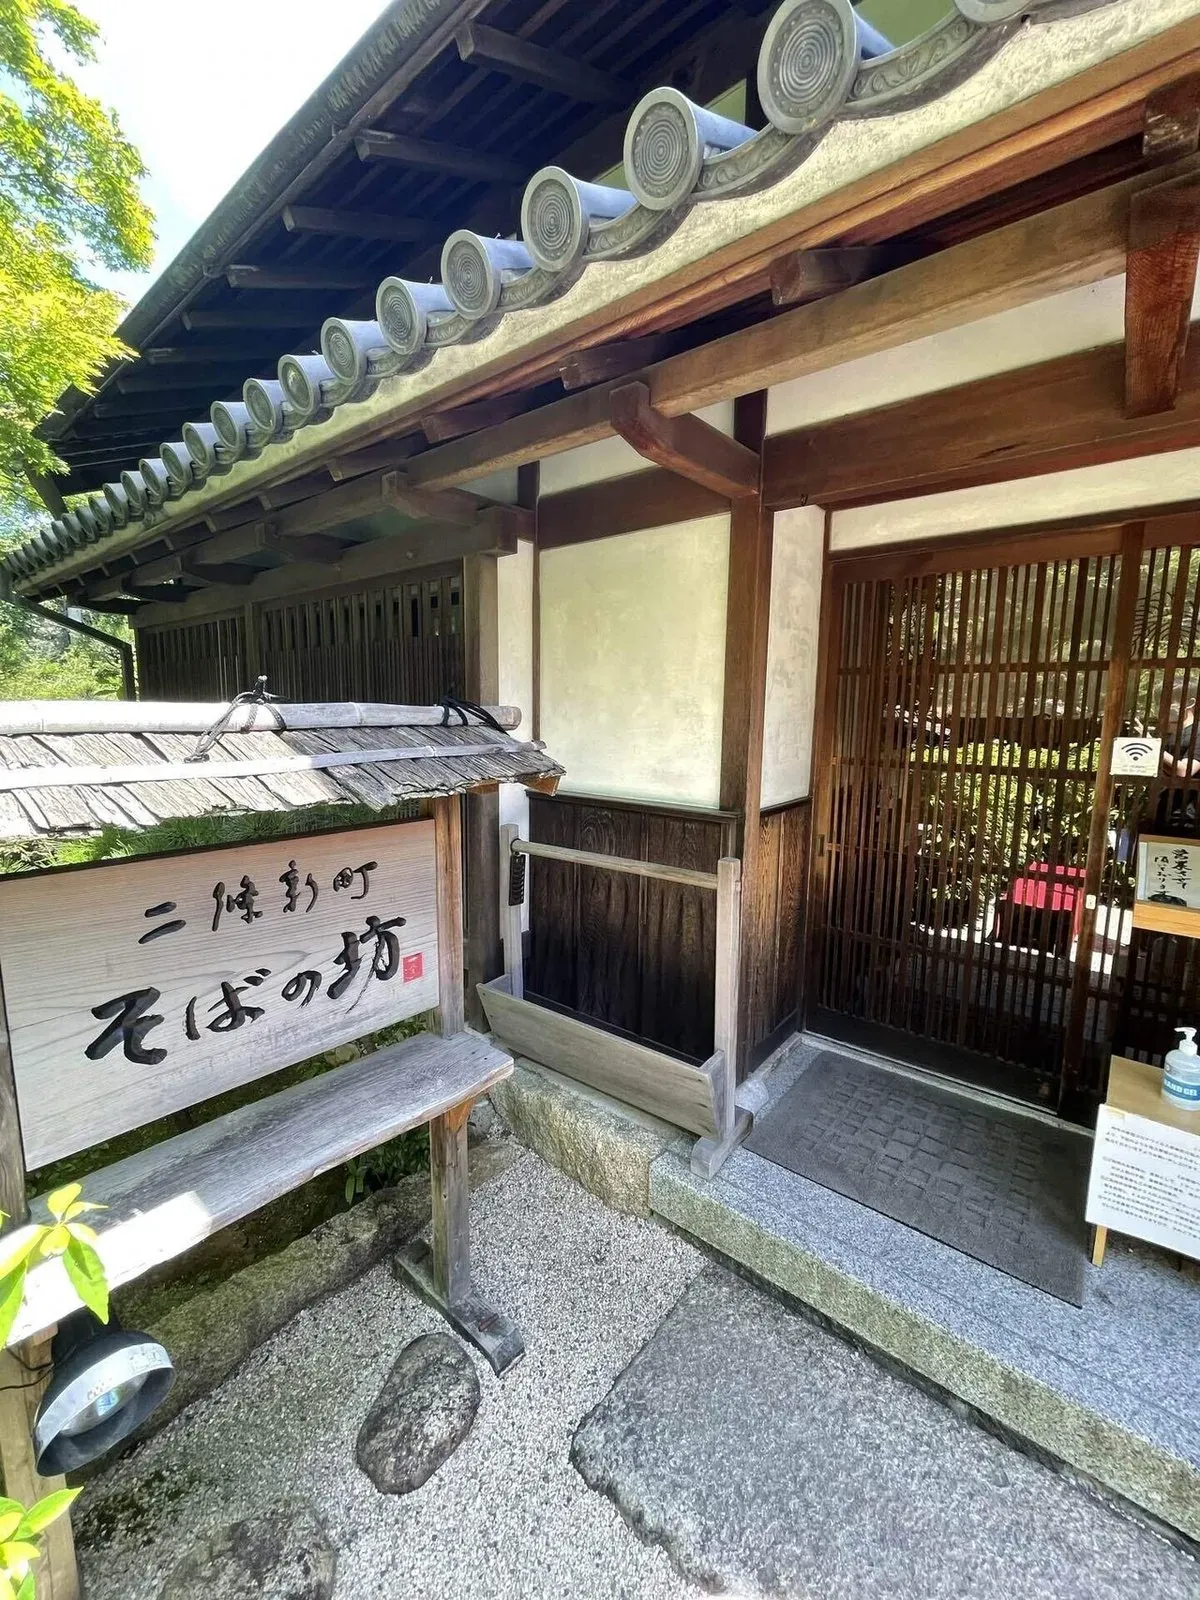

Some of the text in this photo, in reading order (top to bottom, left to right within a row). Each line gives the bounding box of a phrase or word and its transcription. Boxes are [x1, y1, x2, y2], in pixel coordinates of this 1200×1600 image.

[85, 915, 407, 1065] そばの坊
[1183, 1087, 1198, 1097] GEL
